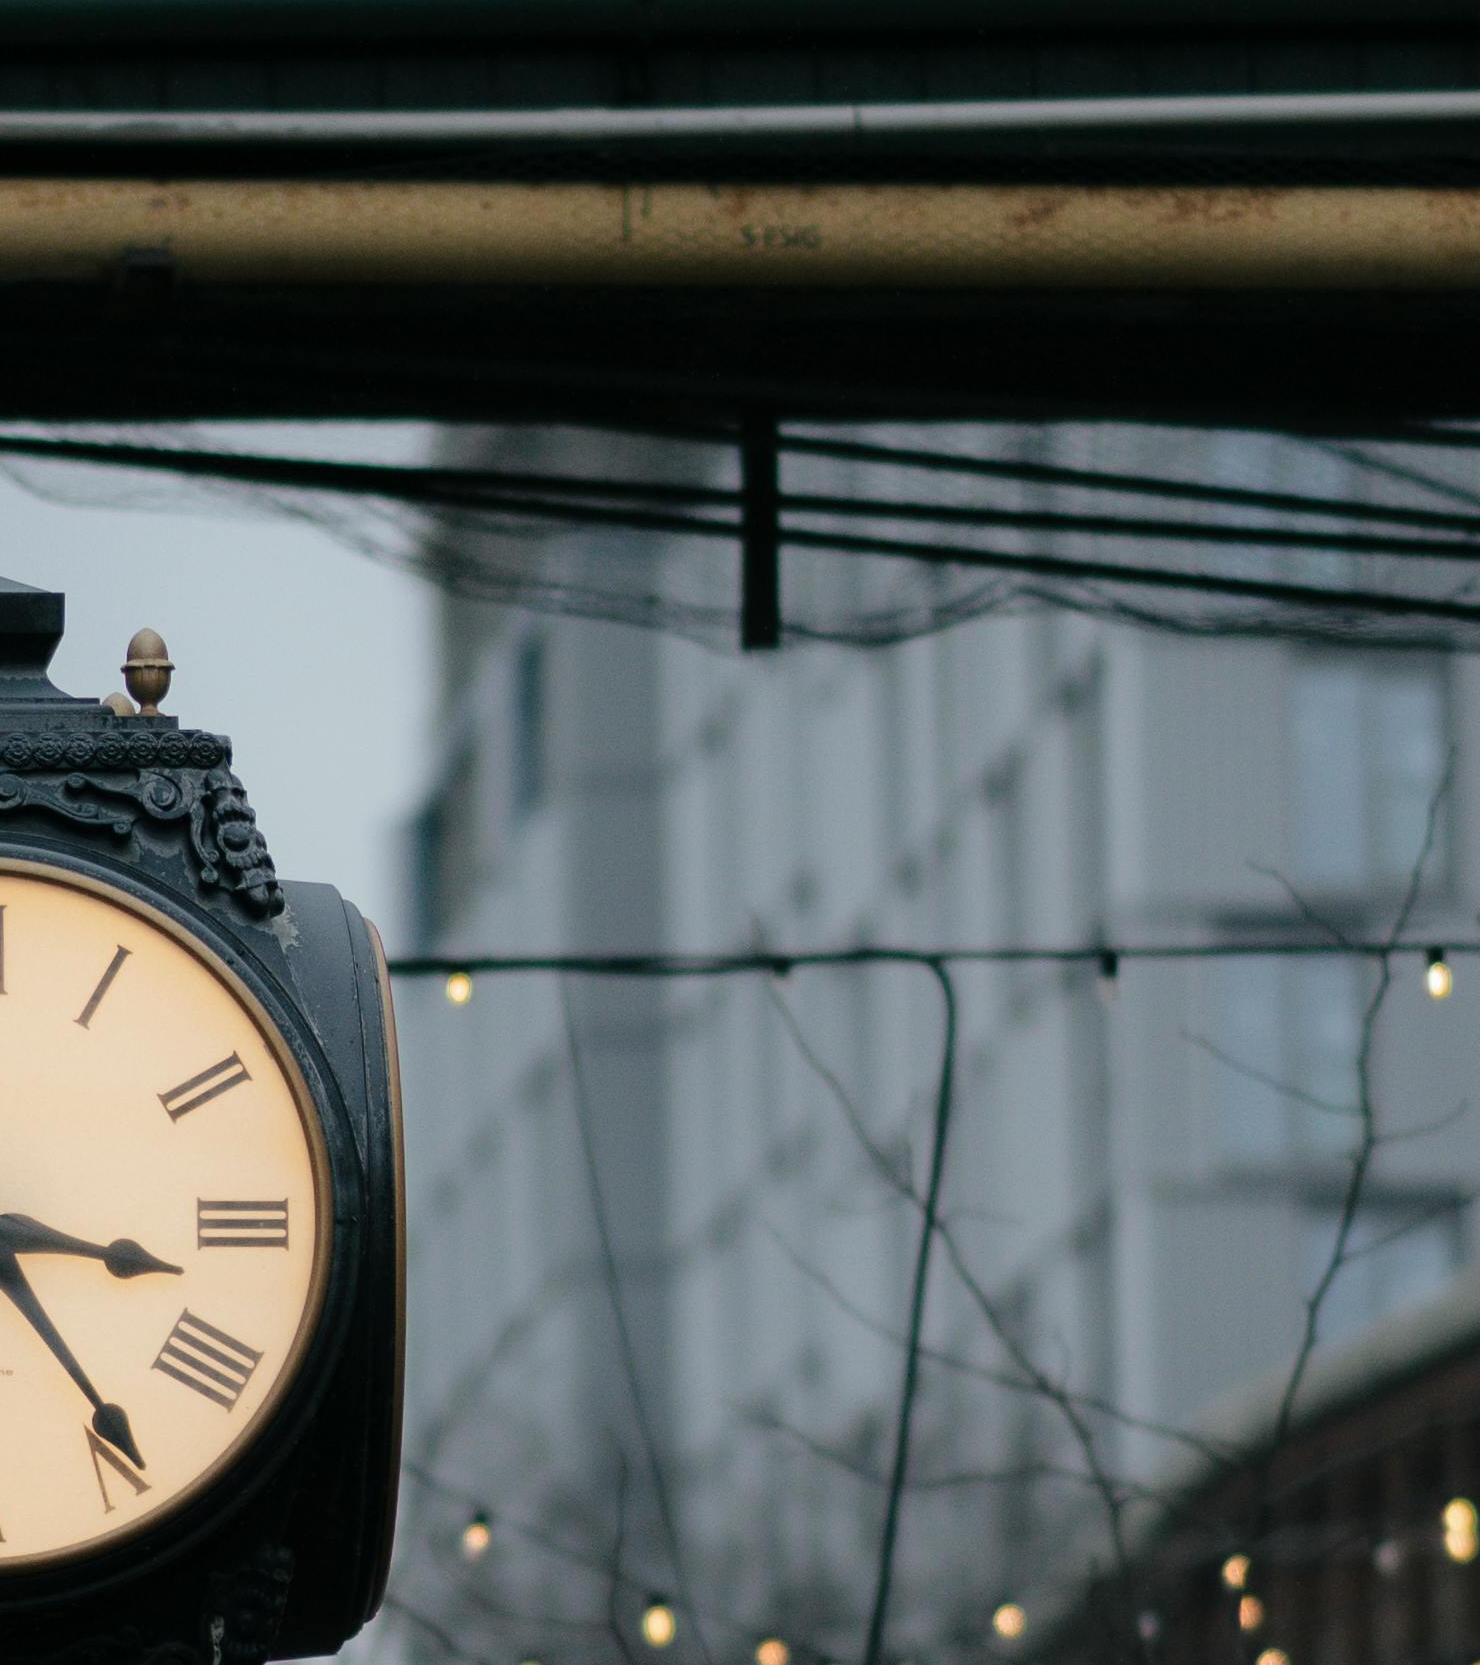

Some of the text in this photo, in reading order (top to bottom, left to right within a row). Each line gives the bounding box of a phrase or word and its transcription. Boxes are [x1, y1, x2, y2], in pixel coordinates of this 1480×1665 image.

[157, 1050, 253, 1124] II
[197, 1197, 289, 1251] III
[84, 1424, 152, 1514] V
